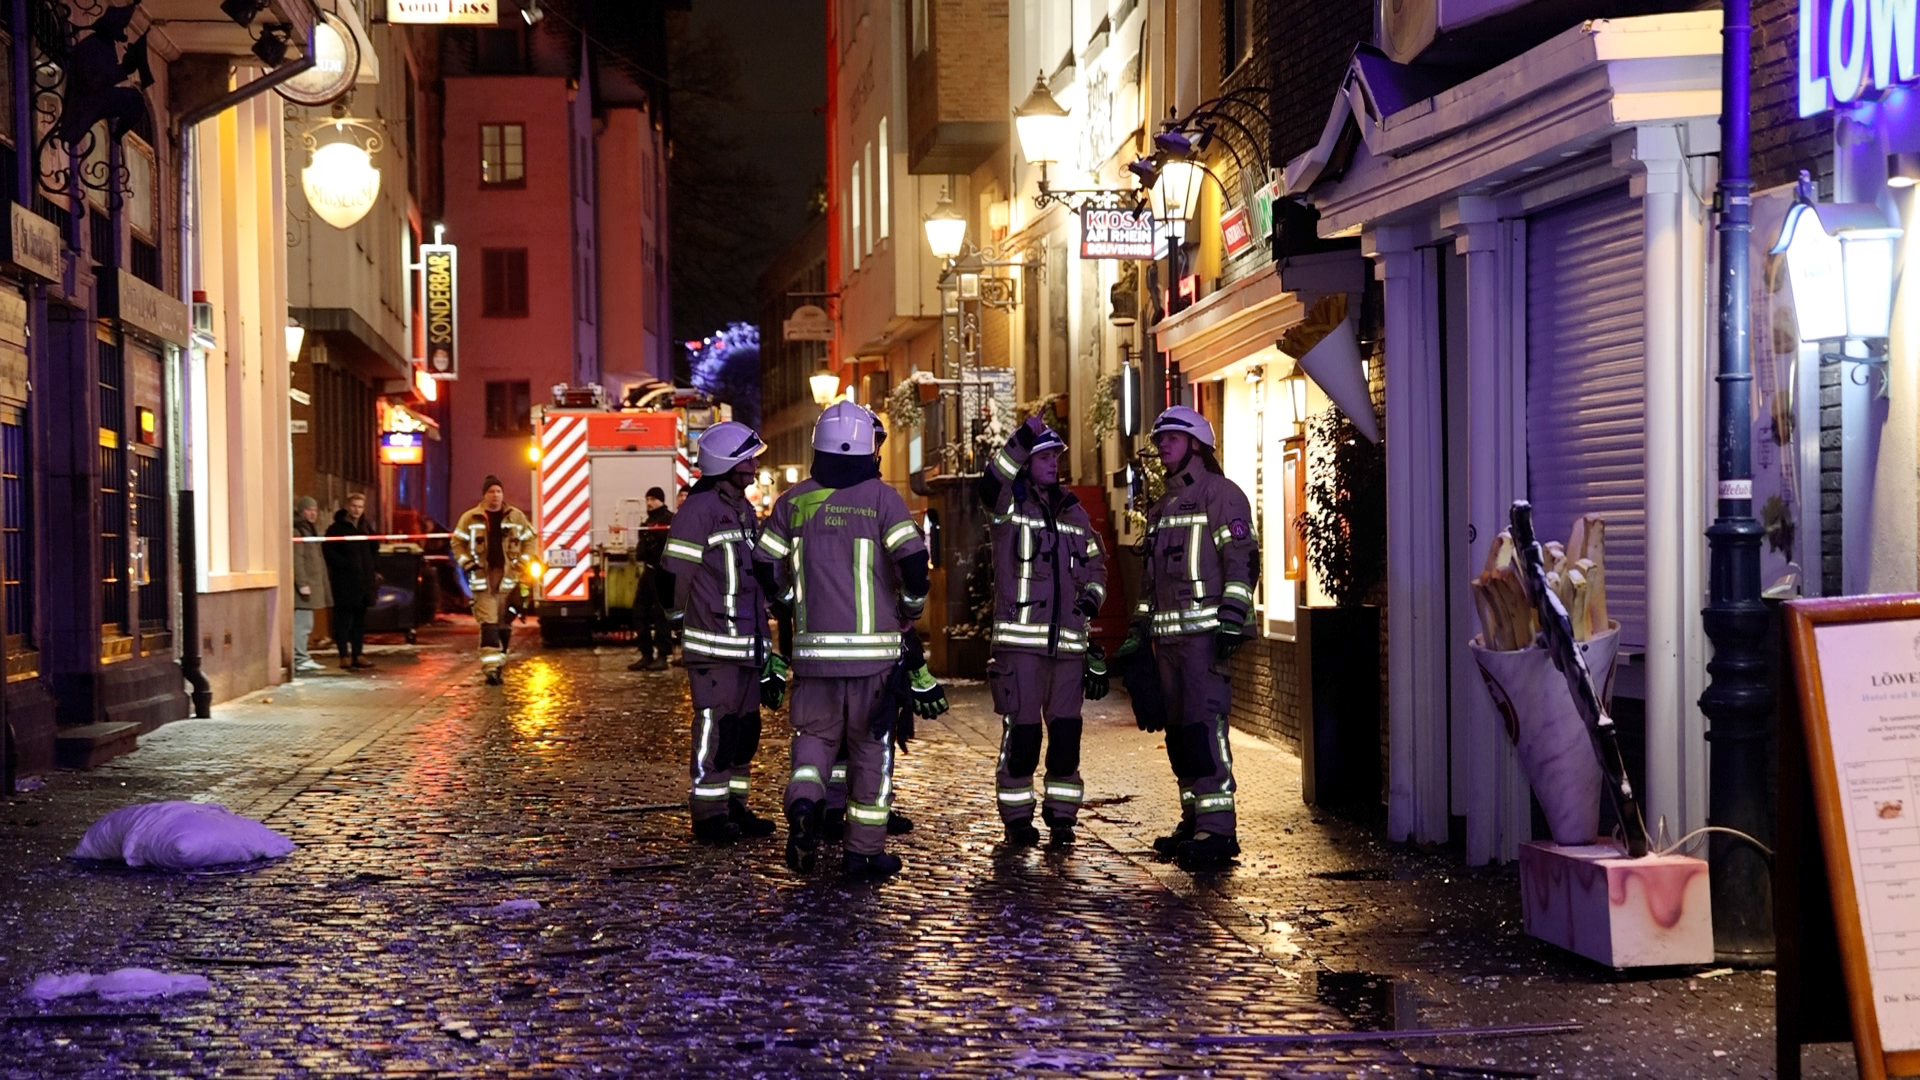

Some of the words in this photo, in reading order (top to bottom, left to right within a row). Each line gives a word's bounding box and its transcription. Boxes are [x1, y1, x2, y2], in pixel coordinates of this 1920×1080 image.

[1086, 210, 1152, 230] KIOSK
[1086, 229, 1109, 242] AM
[1111, 229, 1152, 243] RHEIN
[1086, 243, 1152, 256] SOUVENIRS
[428, 255, 452, 343] SONDERBAR
[825, 516, 847, 526] Köln
[1871, 671, 1920, 687] LÖWE
